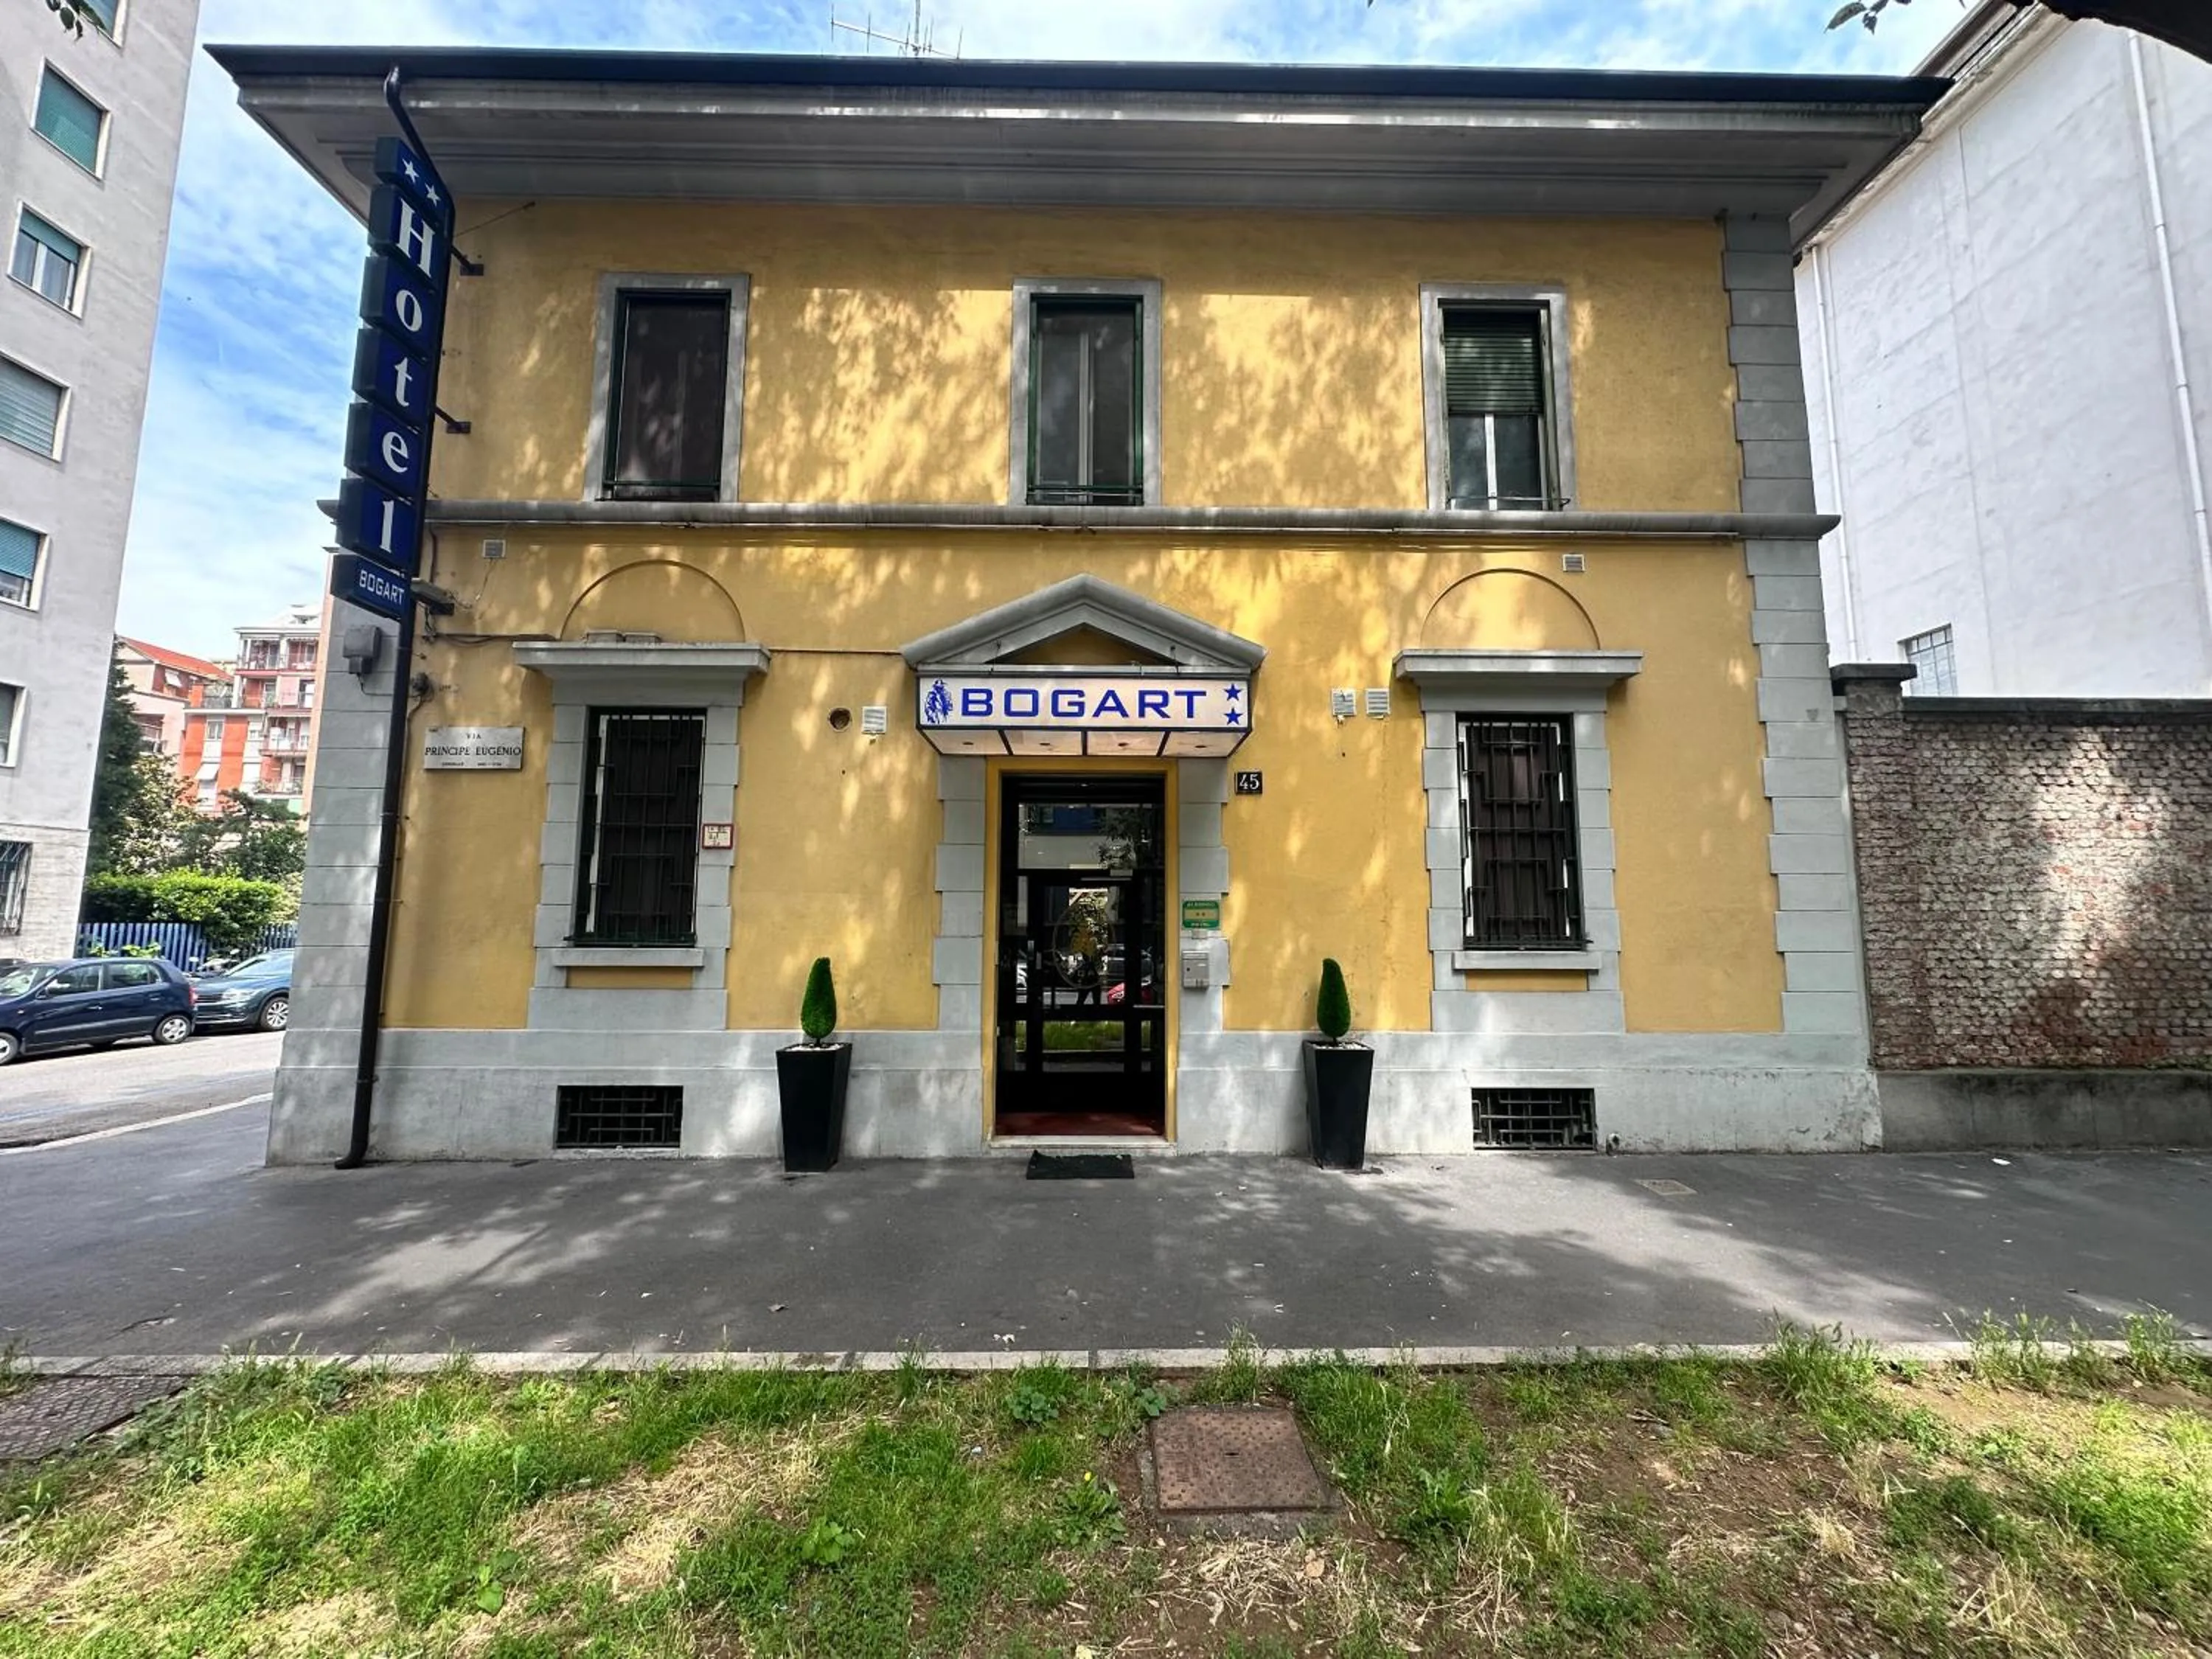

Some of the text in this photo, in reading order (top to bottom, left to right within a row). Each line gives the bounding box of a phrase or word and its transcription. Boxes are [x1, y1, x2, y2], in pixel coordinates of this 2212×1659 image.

[379, 198, 434, 554] Hotel
[359, 569, 405, 605] BOGART
[961, 688, 1206, 719] BOGART
[425, 745, 521, 756] PRINCIPE EUGENIO
[1239, 773, 1260, 790] 45
